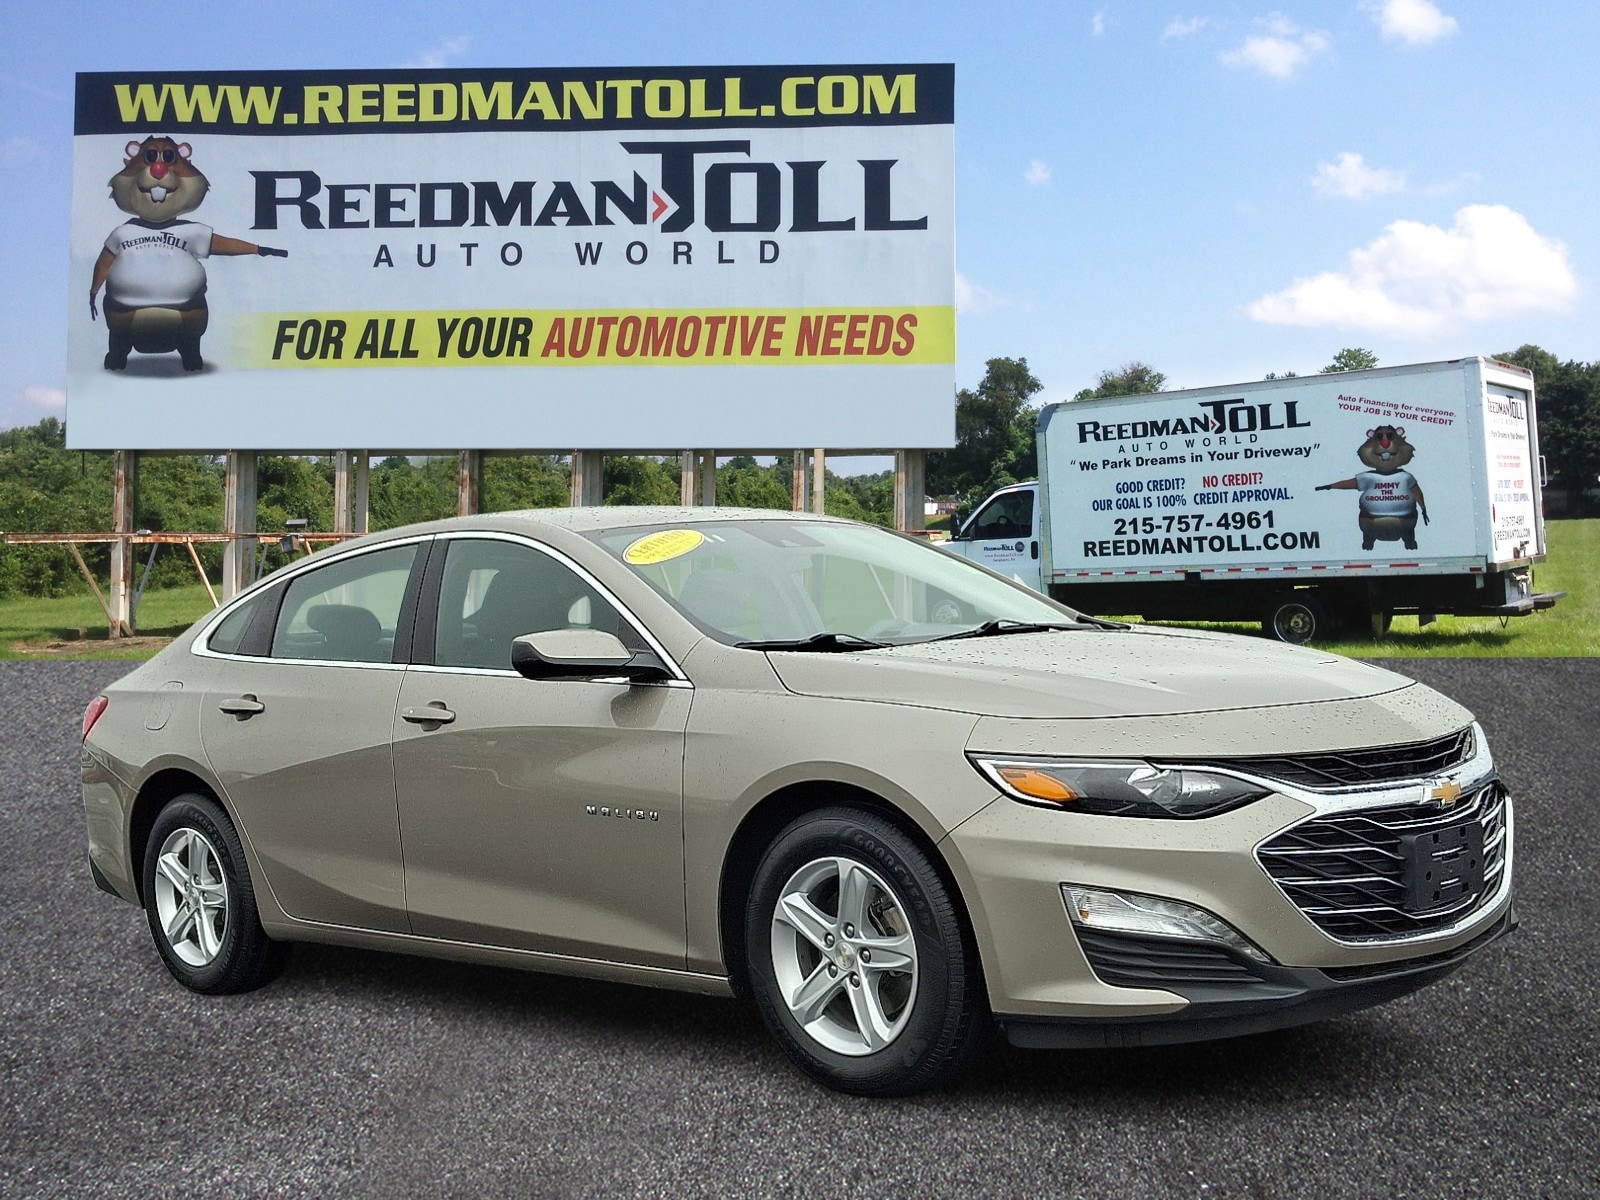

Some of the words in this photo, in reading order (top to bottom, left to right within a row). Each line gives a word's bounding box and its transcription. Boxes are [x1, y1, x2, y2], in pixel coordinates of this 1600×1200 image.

[114, 74, 917, 125] WWW.REEDMANTOLL.COM
[372, 241, 523, 268] AUTO
[574, 240, 780, 266] WORLD
[272, 319, 347, 360] FOR
[354, 318, 420, 360] ALL
[436, 316, 533, 359] YOUR
[540, 314, 787, 358] AUTOMOTIVE
[794, 313, 918, 358] NEEDS
[1338, 394, 1356, 402] Auto
[1359, 397, 1399, 410] Financing
[1401, 403, 1413, 411] for
[1415, 407, 1456, 417] everyone.
[1338, 403, 1361, 412] YOUR
[1364, 406, 1381, 415] JOB
[1394, 411, 1418, 420] YOUR
[1420, 415, 1454, 426] CREDIT
[1118, 441, 1168, 453] AUTO
[1185, 434, 1258, 448] WORLD
[1102, 458, 1131, 469] Park
[1136, 455, 1186, 467] Dreams
[1191, 452, 1203, 462] in
[1207, 451, 1239, 461] Your
[1116, 481, 1143, 494] GOOD
[1147, 478, 1185, 492] CREDIT?
[1202, 475, 1218, 488] NO
[1222, 472, 1263, 487] CREDIT?
[1374, 482, 1400, 490] JIMMY
[1092, 499, 1113, 511] OUR
[1116, 497, 1140, 510] GOAL
[1143, 496, 1152, 508] IS
[1156, 494, 1187, 507] 100%
[1193, 491, 1229, 505] CREDIT
[1232, 488, 1294, 503] APPROVAL.
[1114, 510, 1274, 536] 215-757-4961
[1084, 531, 1320, 558] REEDMANTOLL.COM
